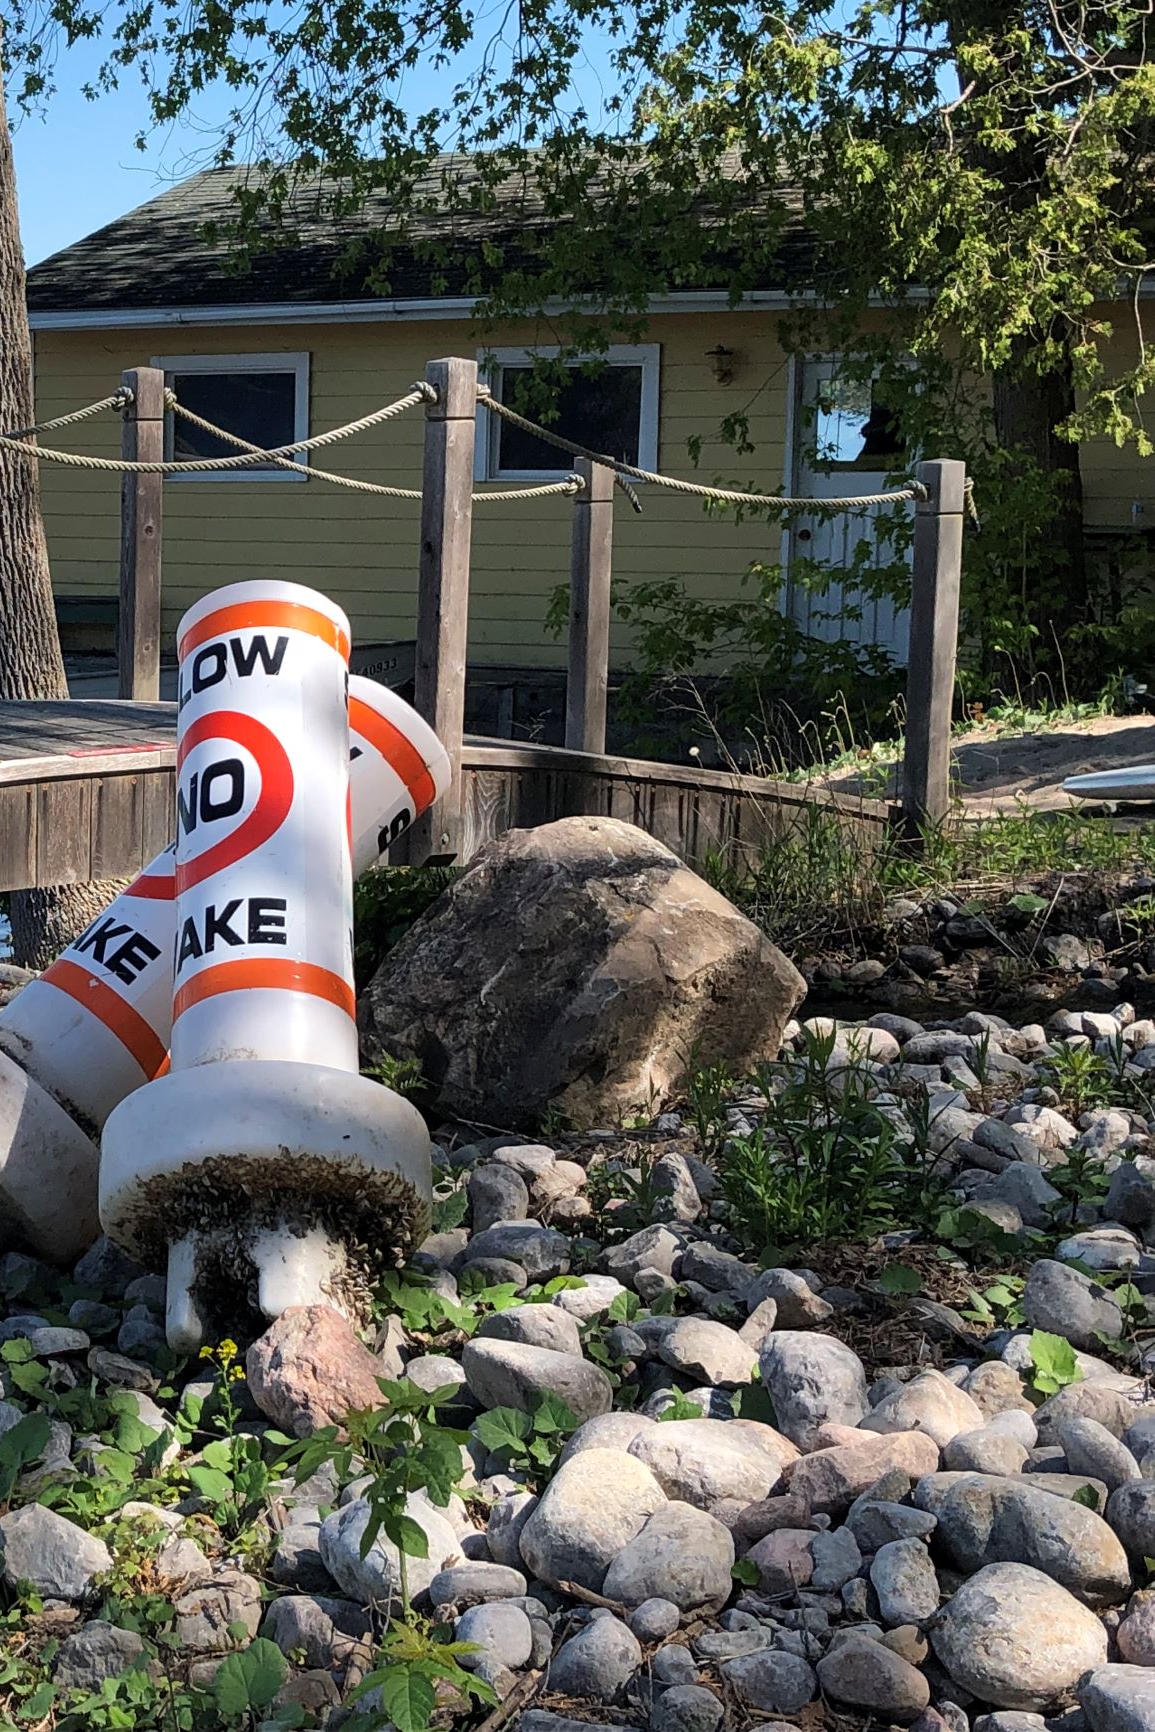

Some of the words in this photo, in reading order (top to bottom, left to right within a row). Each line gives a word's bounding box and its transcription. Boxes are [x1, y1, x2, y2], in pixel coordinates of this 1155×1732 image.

[355, 658, 397, 676] 40933
[178, 758, 245, 835] NO
[175, 898, 287, 976] AKE
